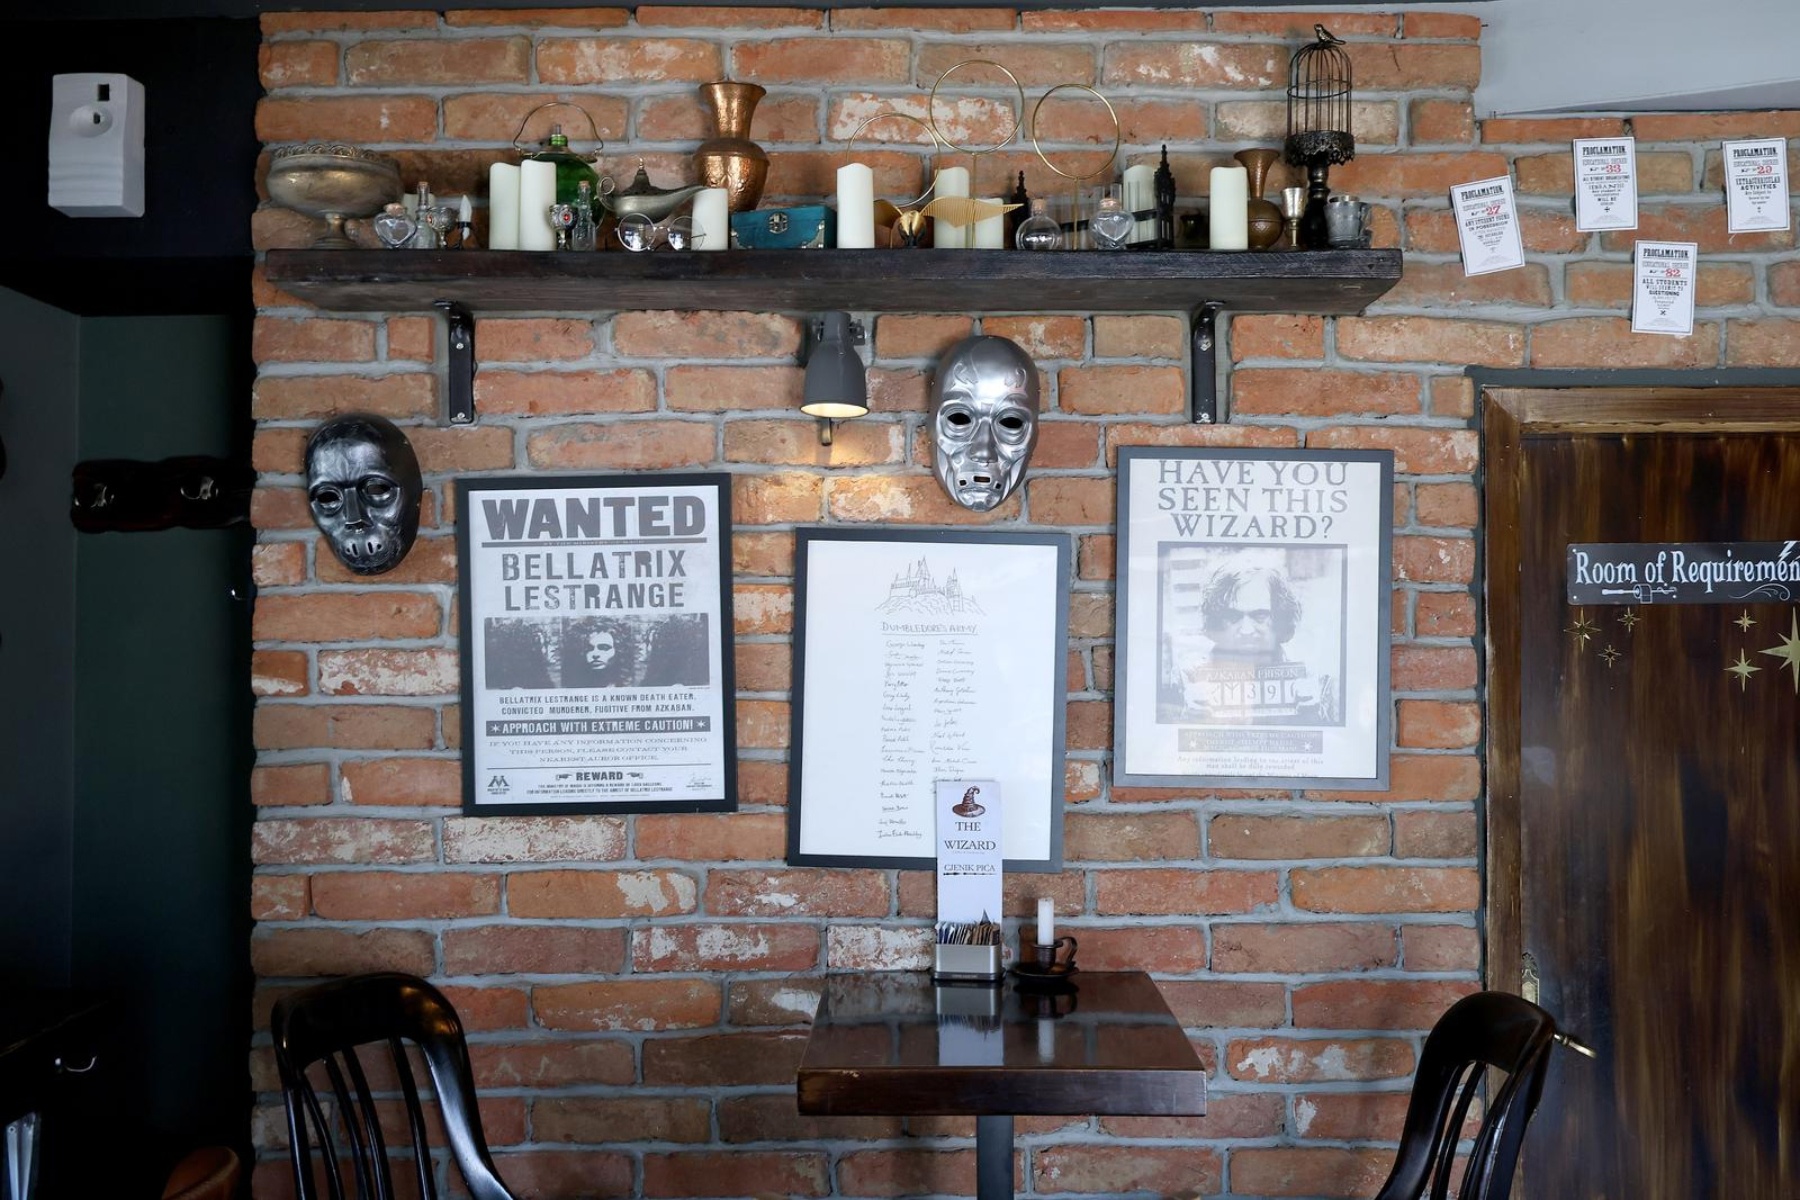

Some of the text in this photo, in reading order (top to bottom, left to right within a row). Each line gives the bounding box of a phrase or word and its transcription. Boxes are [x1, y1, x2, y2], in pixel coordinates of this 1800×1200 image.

[1606, 164, 1621, 174] 33
[1740, 183, 1777, 191] ACTIVITIES
[1486, 205, 1501, 216] 27
[1665, 268, 1681, 277] 82
[1158, 460, 1349, 486] HAVE YOU
[1158, 487, 1348, 514] SEEN THIS
[482, 495, 707, 540] WANTED
[1170, 513, 1333, 539] WIZARD?
[502, 550, 686, 581] BELLATRIX
[1575, 551, 1638, 585] Room
[1644, 551, 1667, 583] of
[504, 582, 685, 611] LESTRANGE
[1258, 668, 1298, 680] PRISON
[499, 696, 542, 704] BELLATRIX
[545, 695, 589, 703] LESTRANGE
[591, 694, 599, 702] IS
[602, 694, 610, 702] A
[610, 694, 637, 702] KNOWN
[640, 693, 666, 701] DEATH
[501, 706, 544, 715] CONVICTED
[595, 705, 628, 713] FUGITIVE
[631, 704, 652, 712] FROM
[502, 719, 694, 734] APPROACH WITH EXTREME CAUTION!
[576, 771, 623, 781] REWARD
[955, 821, 982, 832] THE
[944, 839, 997, 850] WIZARD
